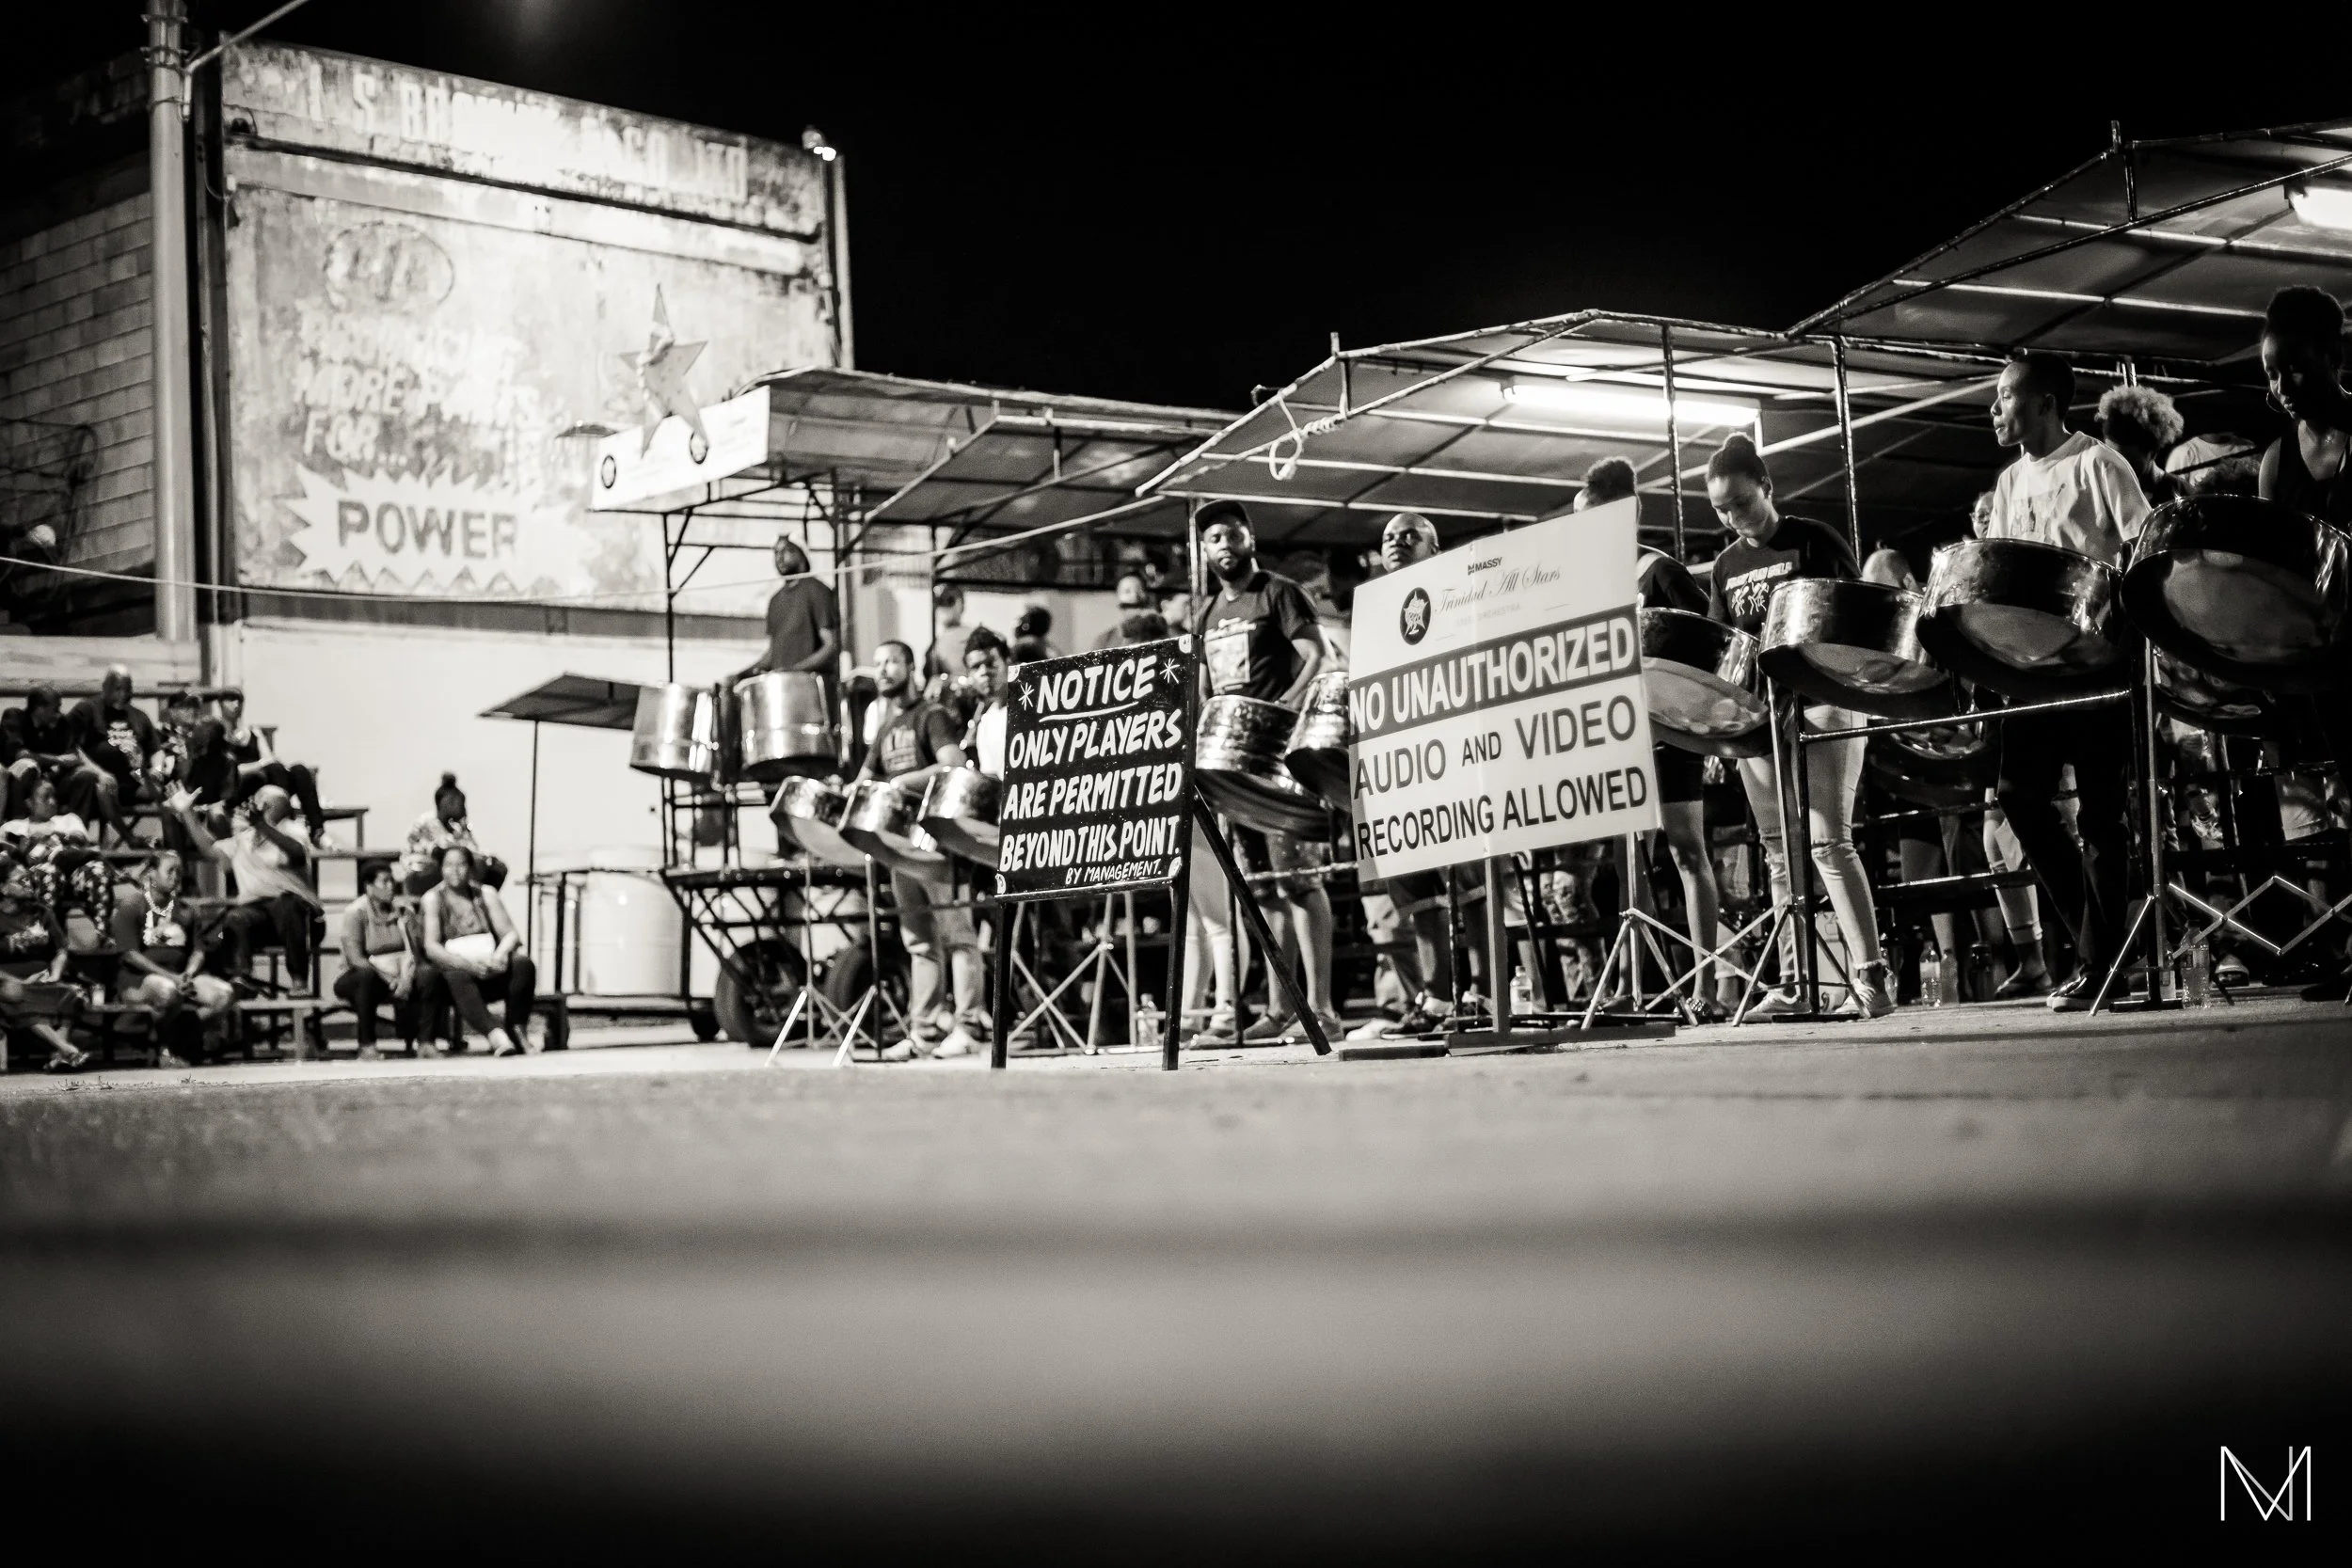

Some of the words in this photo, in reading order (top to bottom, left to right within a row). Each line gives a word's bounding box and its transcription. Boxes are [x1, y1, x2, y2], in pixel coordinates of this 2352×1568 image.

[338, 499, 516, 559] POWER
[1435, 580, 1487, 613] Trinidad
[1489, 568, 1520, 598] All
[1522, 562, 1561, 589] Stars
[1475, 557, 1502, 572] MASSY
[1037, 656, 1157, 713] NOTICE
[1349, 682, 1385, 736] NO
[1392, 616, 1635, 724] UNAUTHORIZED
[1009, 725, 1068, 769] ONLY
[1069, 709, 1182, 762] PLAYERS
[1354, 738, 1446, 800] AUDIO
[1461, 731, 1502, 767] AND
[1515, 694, 1636, 760] VIDEO
[1003, 780, 1048, 820] ARE
[1049, 763, 1183, 816] PERMITTED
[1358, 795, 1494, 861] RECORDING
[1503, 766, 1647, 831] ALLOWED
[999, 829, 1073, 872] BEYOND
[1076, 823, 1117, 863] THIS
[1119, 816, 1180, 860] POINT.
[1066, 867, 1081, 885] BY
[1084, 859, 1162, 882] MANAGEMENT.
